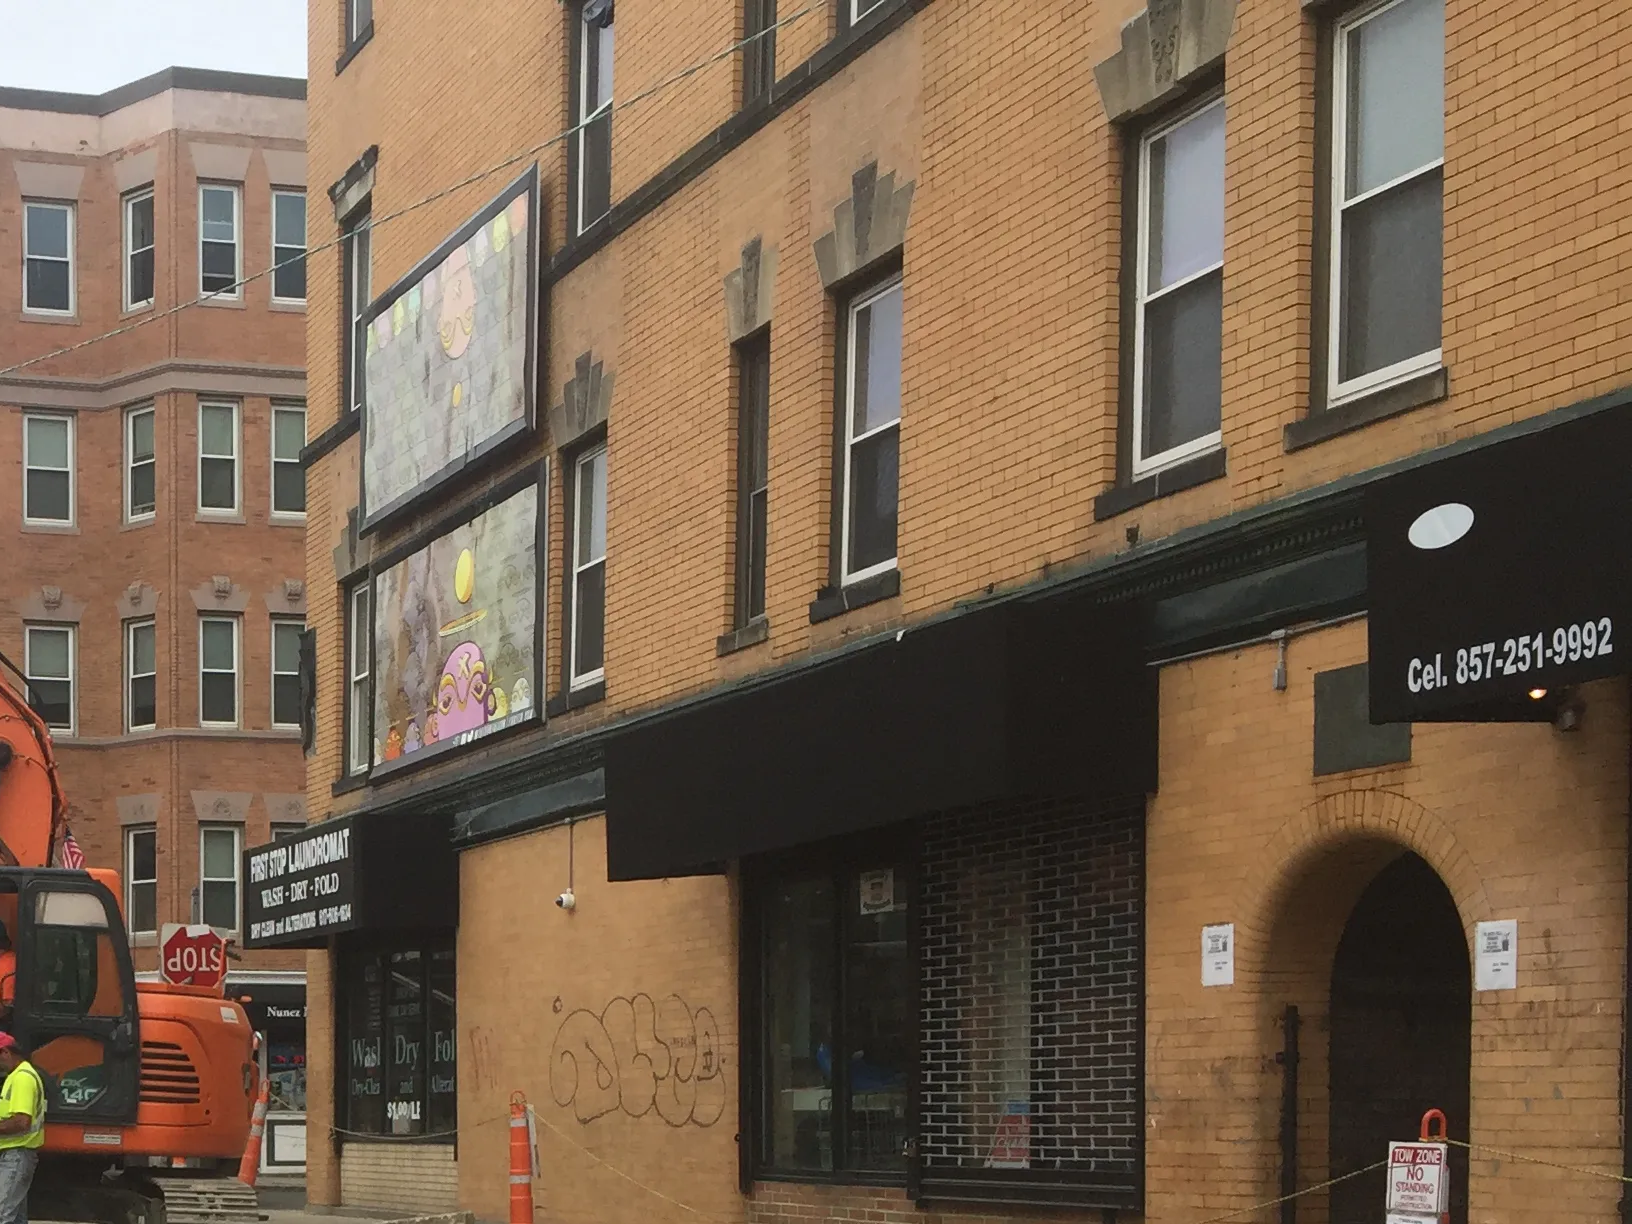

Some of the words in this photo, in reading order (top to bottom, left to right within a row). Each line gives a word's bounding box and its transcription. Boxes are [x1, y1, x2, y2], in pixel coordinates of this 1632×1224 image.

[1407, 653, 1448, 693] Cel.
[1455, 617, 1613, 685] 857-251-9992
[250, 853, 269, 883] FIRST
[269, 847, 287, 878] STOP
[288, 828, 350, 873] LAUNDROMAT
[261, 886, 284, 908] WASH
[290, 880, 308, 902] DRY
[314, 872, 340, 897] FOLD
[167, 947, 222, 972] STOP
[267, 1006, 301, 1017] Nunez
[395, 1034, 419, 1071] Dry
[434, 1029, 455, 1063] Fol
[1394, 1148, 1414, 1162] TOW
[1415, 1149, 1441, 1163] ZONE
[1407, 1166, 1424, 1181] NO
[1395, 1181, 1435, 1195] STANDING
